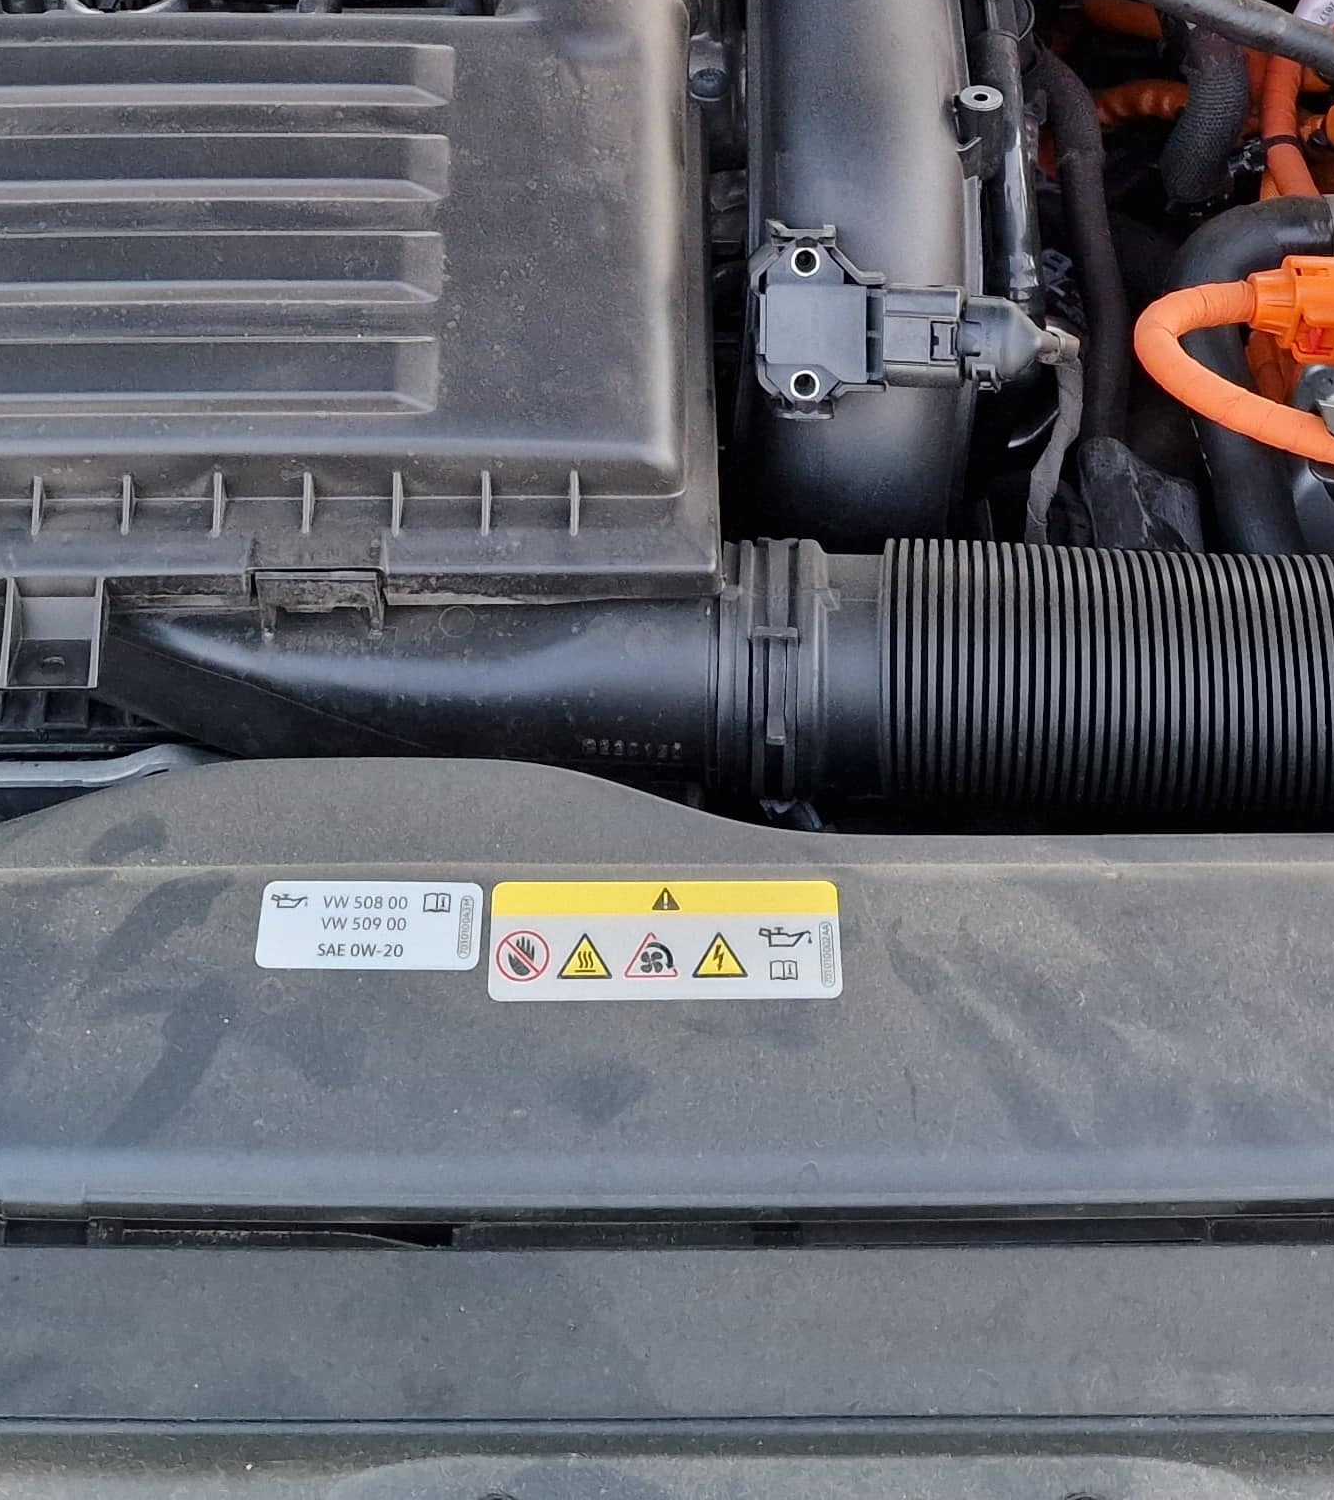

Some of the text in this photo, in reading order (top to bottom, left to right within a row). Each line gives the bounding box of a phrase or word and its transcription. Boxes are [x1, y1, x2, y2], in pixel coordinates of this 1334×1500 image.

[323, 895, 408, 910] VW 508 00
[321, 916, 407, 932] VW 509 00
[317, 943, 403, 958] SAE 0W-20
